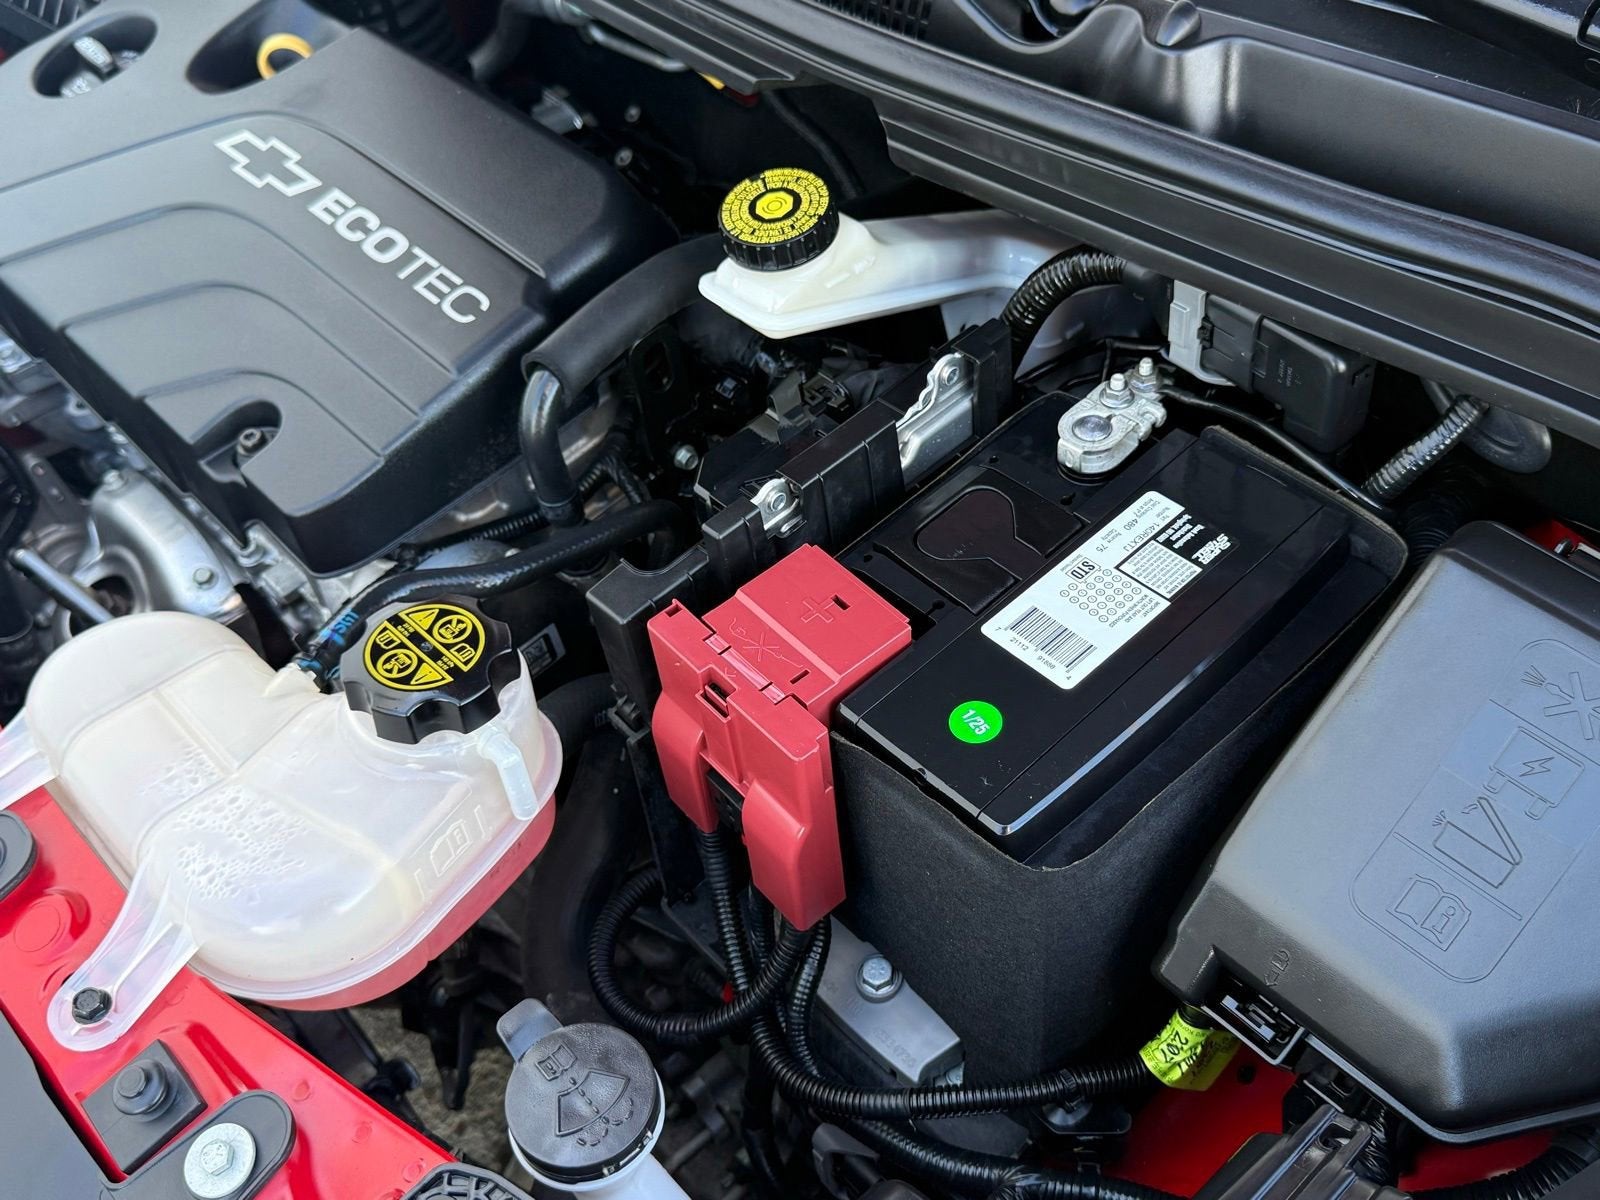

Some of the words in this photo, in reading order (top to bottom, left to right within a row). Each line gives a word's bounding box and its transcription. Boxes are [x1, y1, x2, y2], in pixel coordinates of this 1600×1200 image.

[308, 190, 491, 324] ECOTEC
[1122, 517, 1139, 531] 480
[1094, 542, 1108, 553] 75
[1193, 533, 1229, 562] START
[1199, 539, 1231, 565] SUPER
[1069, 559, 1095, 580] STD
[1009, 636, 1029, 651] 21112
[961, 708, 991, 735] 1/25
